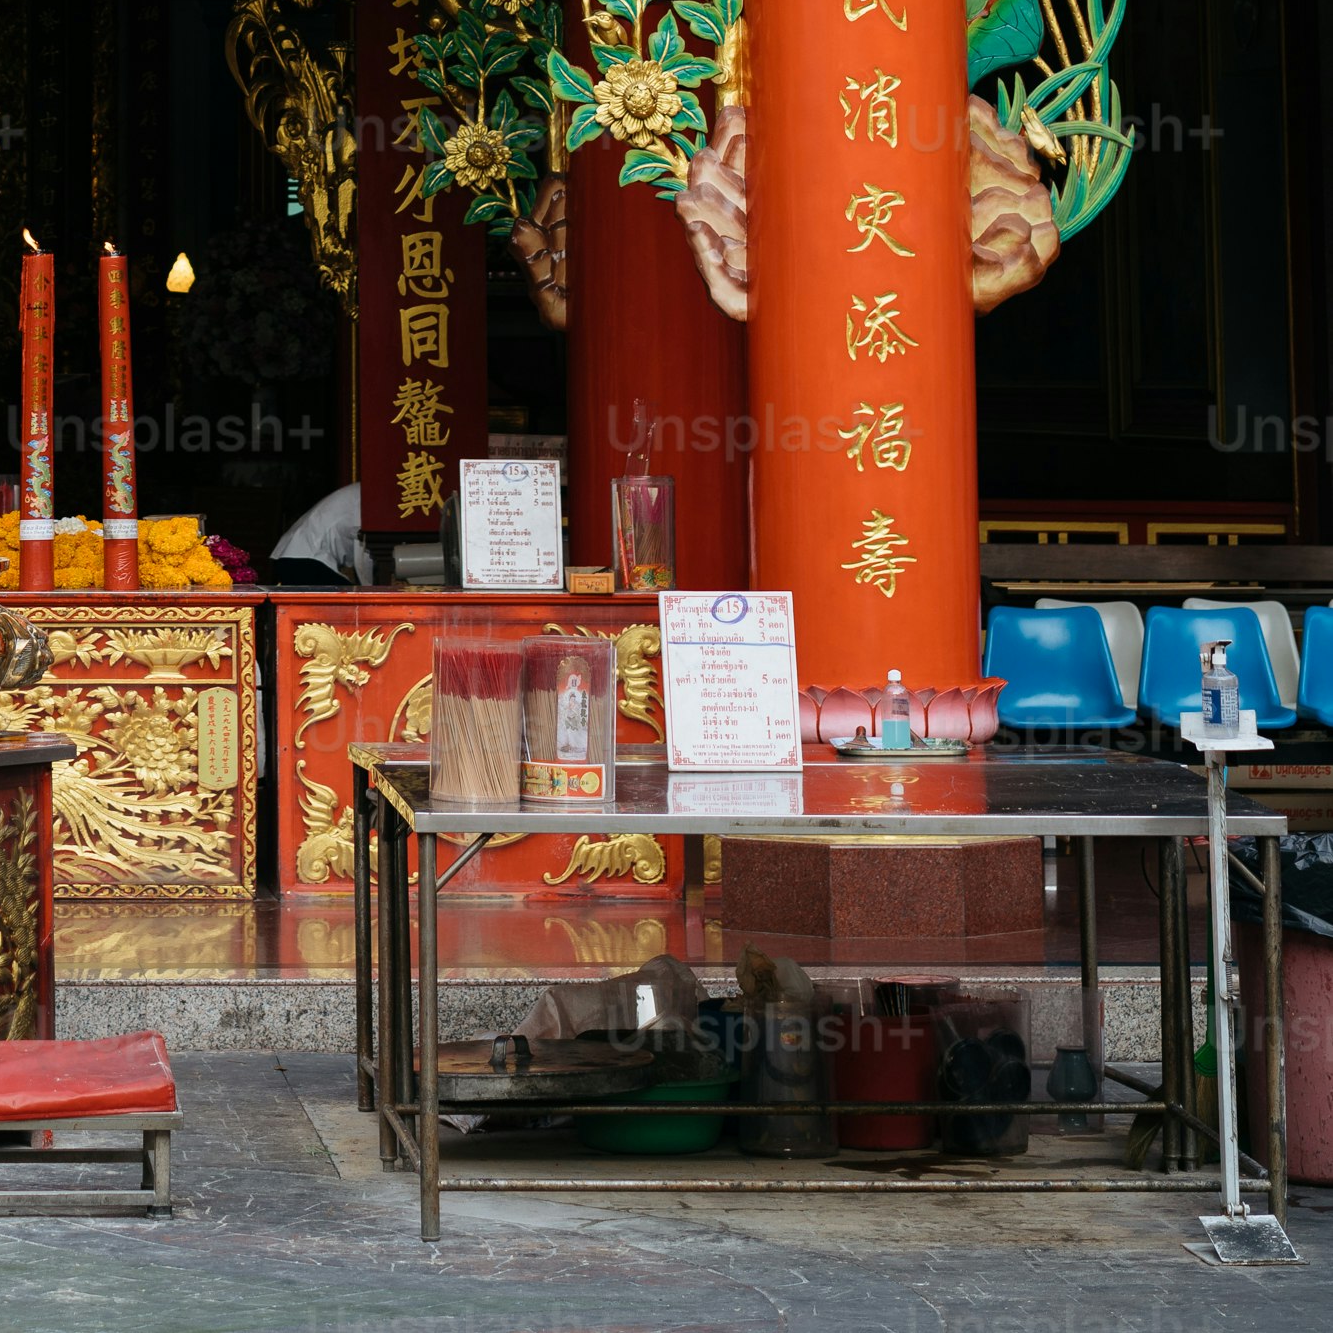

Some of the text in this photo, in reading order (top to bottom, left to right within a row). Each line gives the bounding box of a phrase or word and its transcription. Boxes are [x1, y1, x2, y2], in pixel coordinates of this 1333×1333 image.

[509, 466, 519, 475] 15
[534, 488, 539, 496] 3
[726, 601, 740, 614] 15
[758, 618, 765, 629] 5
[759, 632, 766, 642] 3
[762, 674, 769, 684] 5
[766, 716, 771, 726] 1
[767, 729, 772, 740] 1
